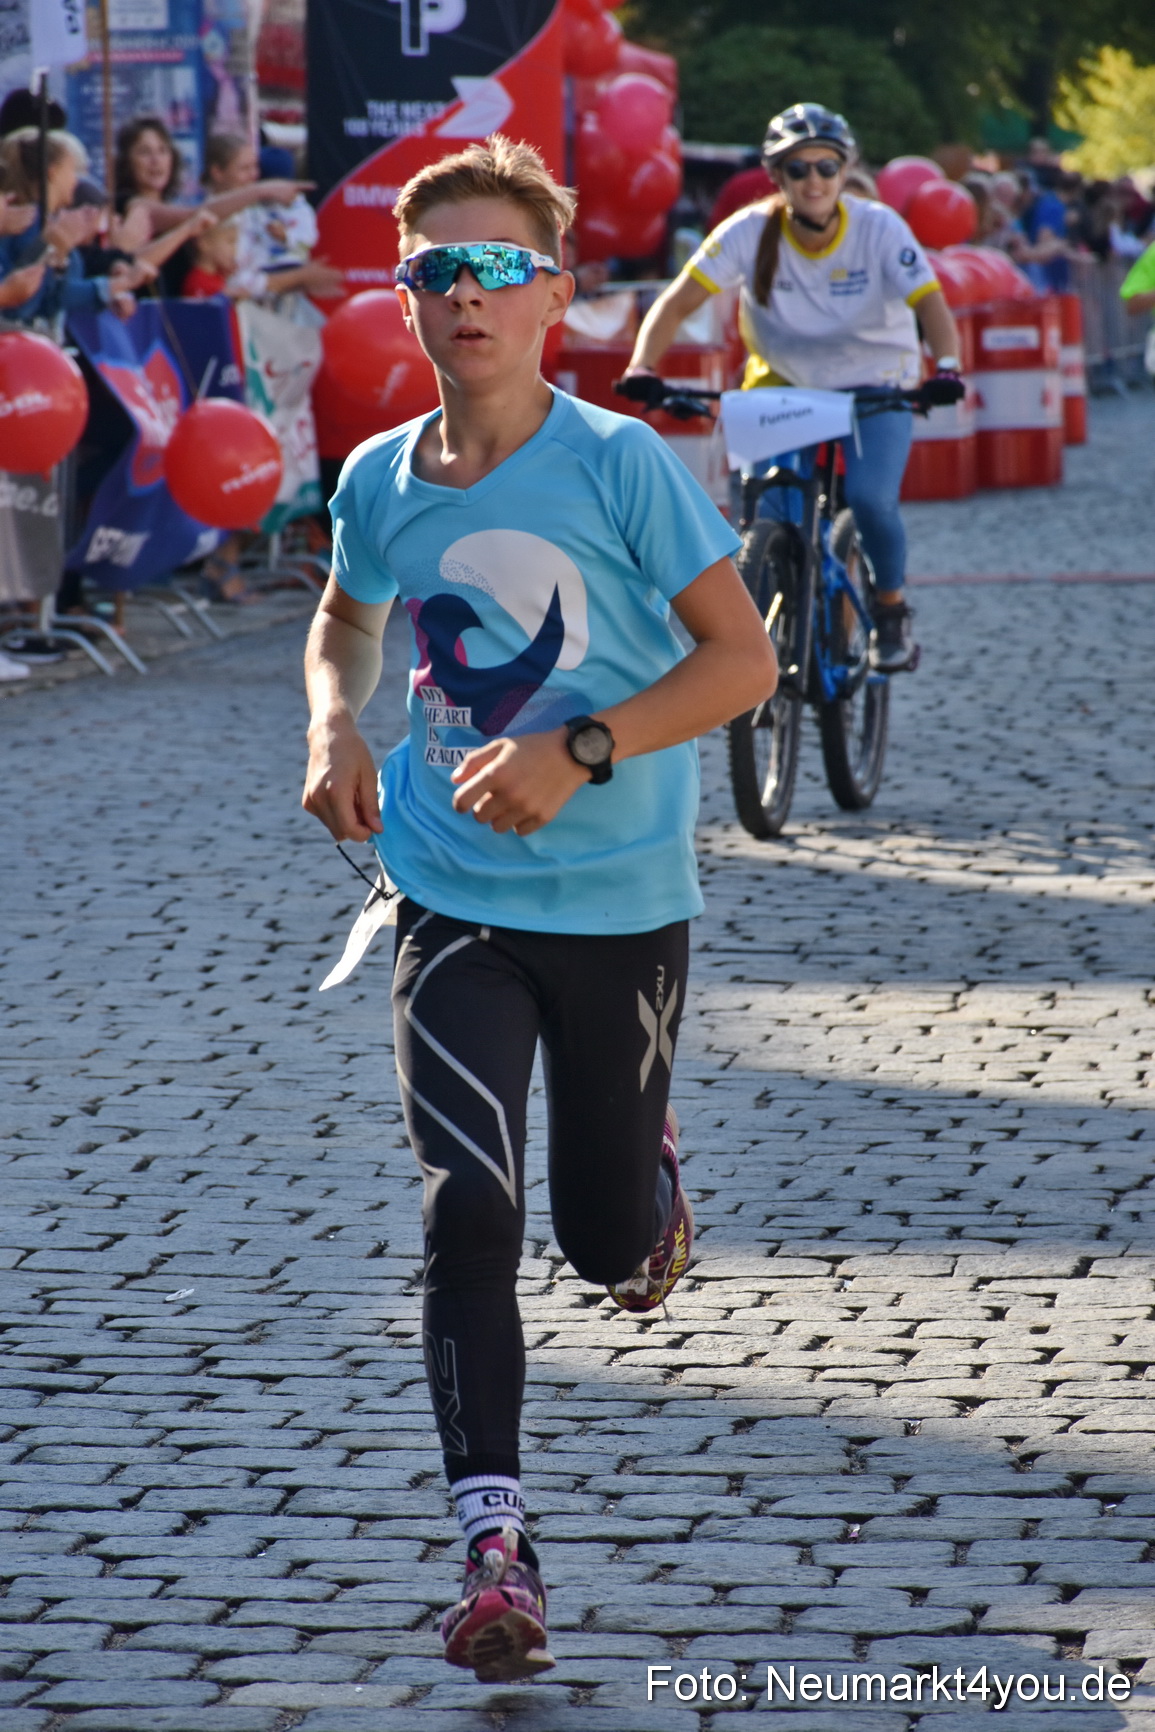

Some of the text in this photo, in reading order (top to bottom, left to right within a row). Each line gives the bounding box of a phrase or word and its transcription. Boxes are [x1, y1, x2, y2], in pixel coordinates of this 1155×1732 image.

[421, 687, 443, 703] MY
[425, 706, 469, 725] HEART
[428, 725, 440, 742] IS
[425, 747, 470, 766] RACIN
